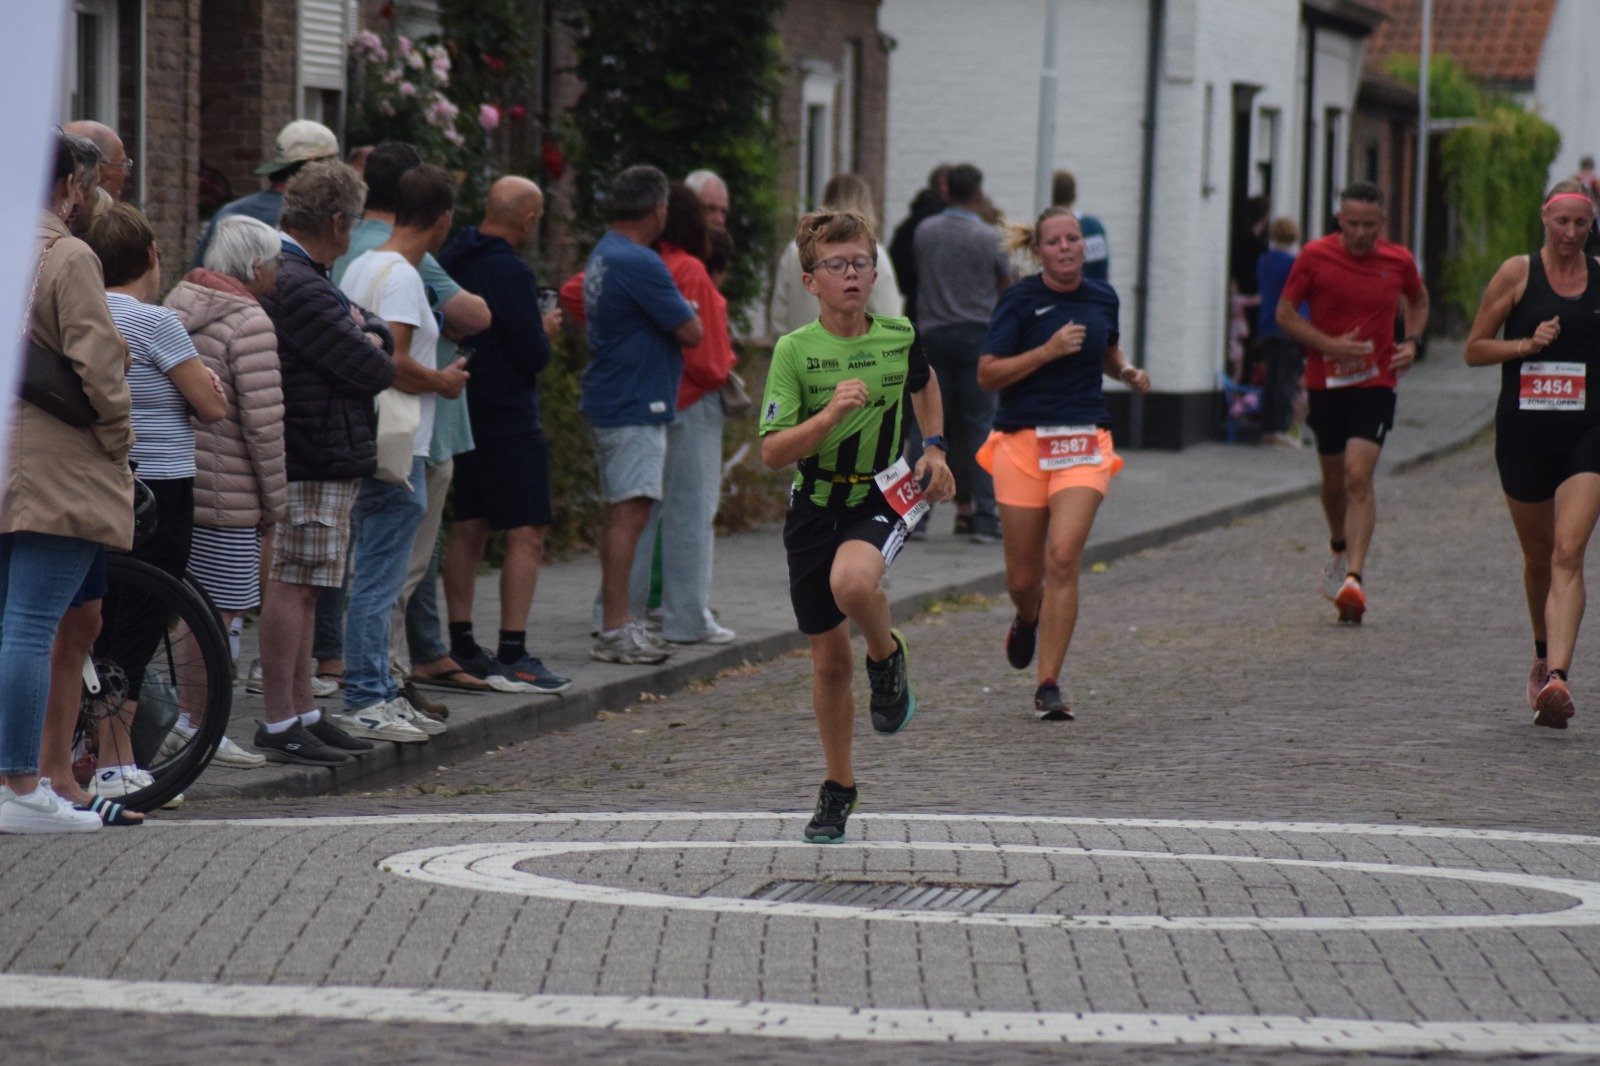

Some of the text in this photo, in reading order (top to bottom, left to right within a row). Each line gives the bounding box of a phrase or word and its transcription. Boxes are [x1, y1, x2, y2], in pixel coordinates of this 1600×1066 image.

[847, 360, 877, 370] Athlex
[1532, 379, 1573, 395] 3454
[1527, 398, 1577, 406] ZOMERLOPEN
[1050, 437, 1088, 455] 2587
